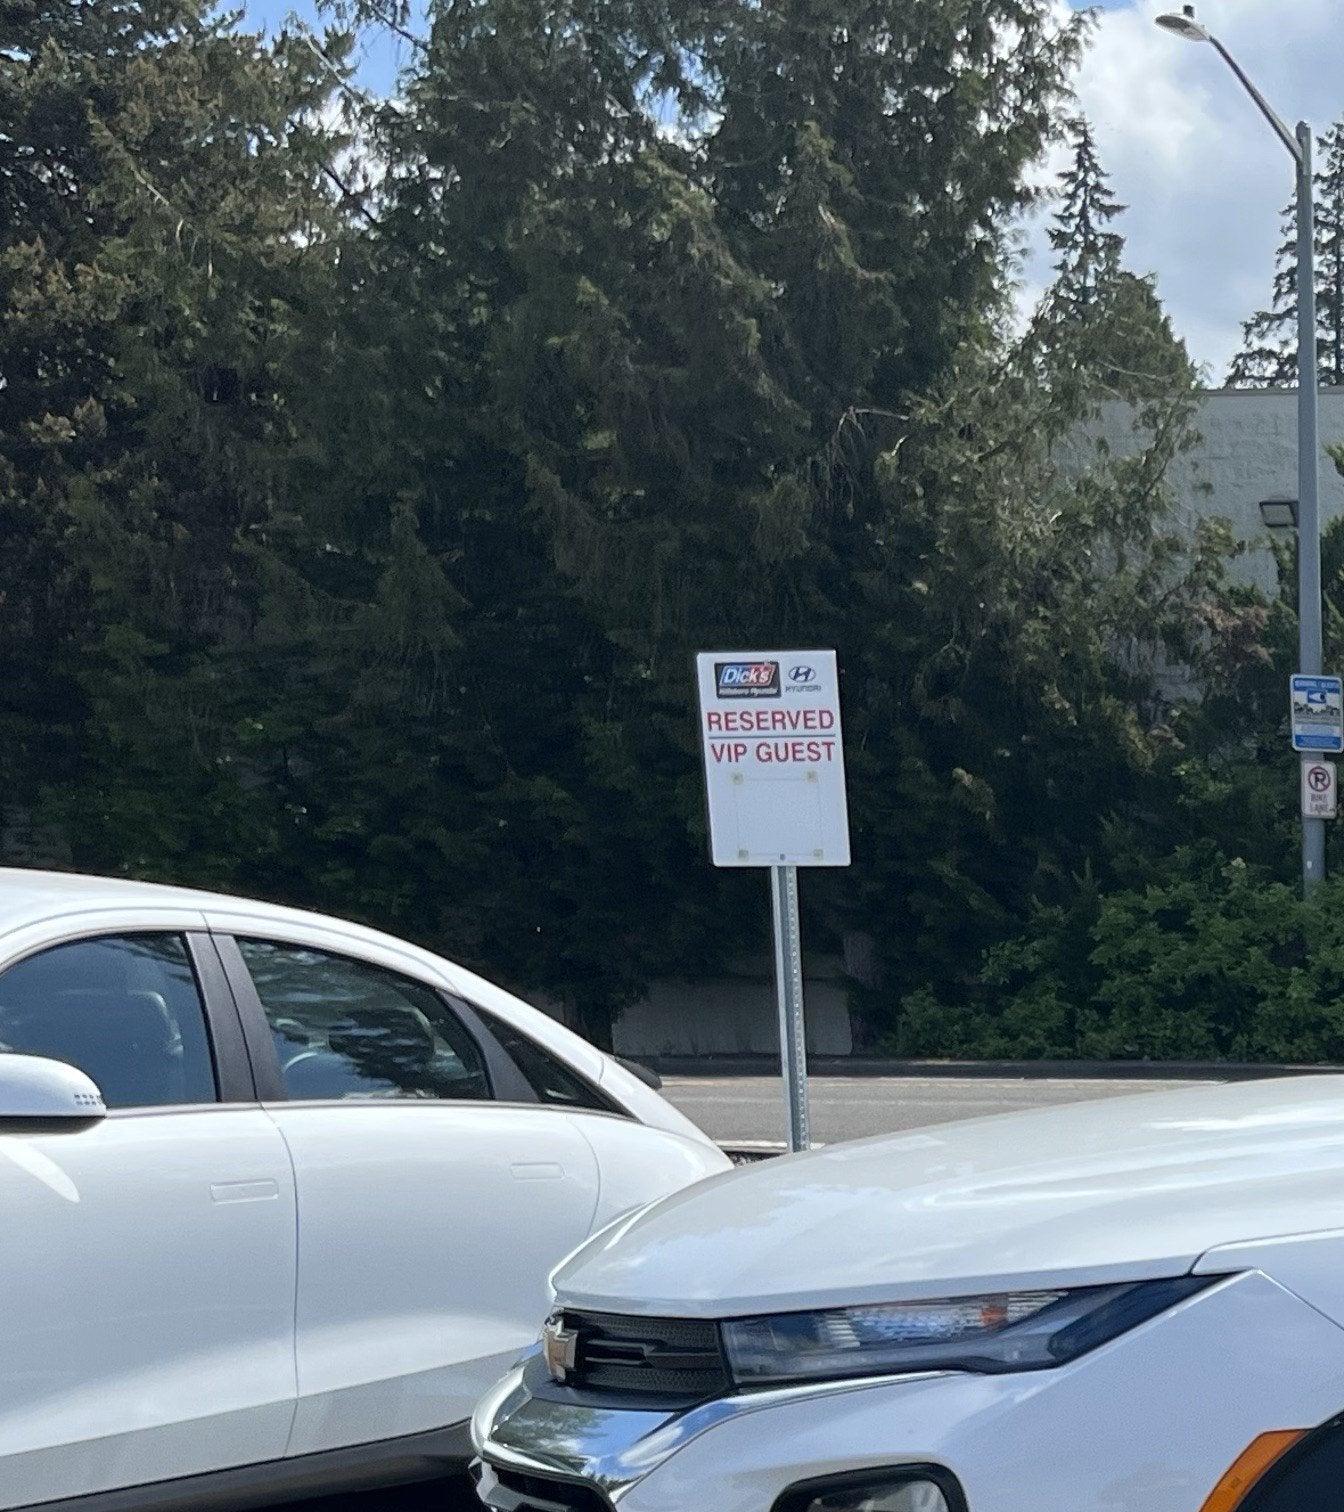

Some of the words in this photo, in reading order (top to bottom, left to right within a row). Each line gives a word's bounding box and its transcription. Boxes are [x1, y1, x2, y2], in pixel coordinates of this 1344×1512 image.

[707, 710, 834, 731] RESERVED
[711, 743, 747, 763] VIP
[756, 742, 835, 762] GUEST
